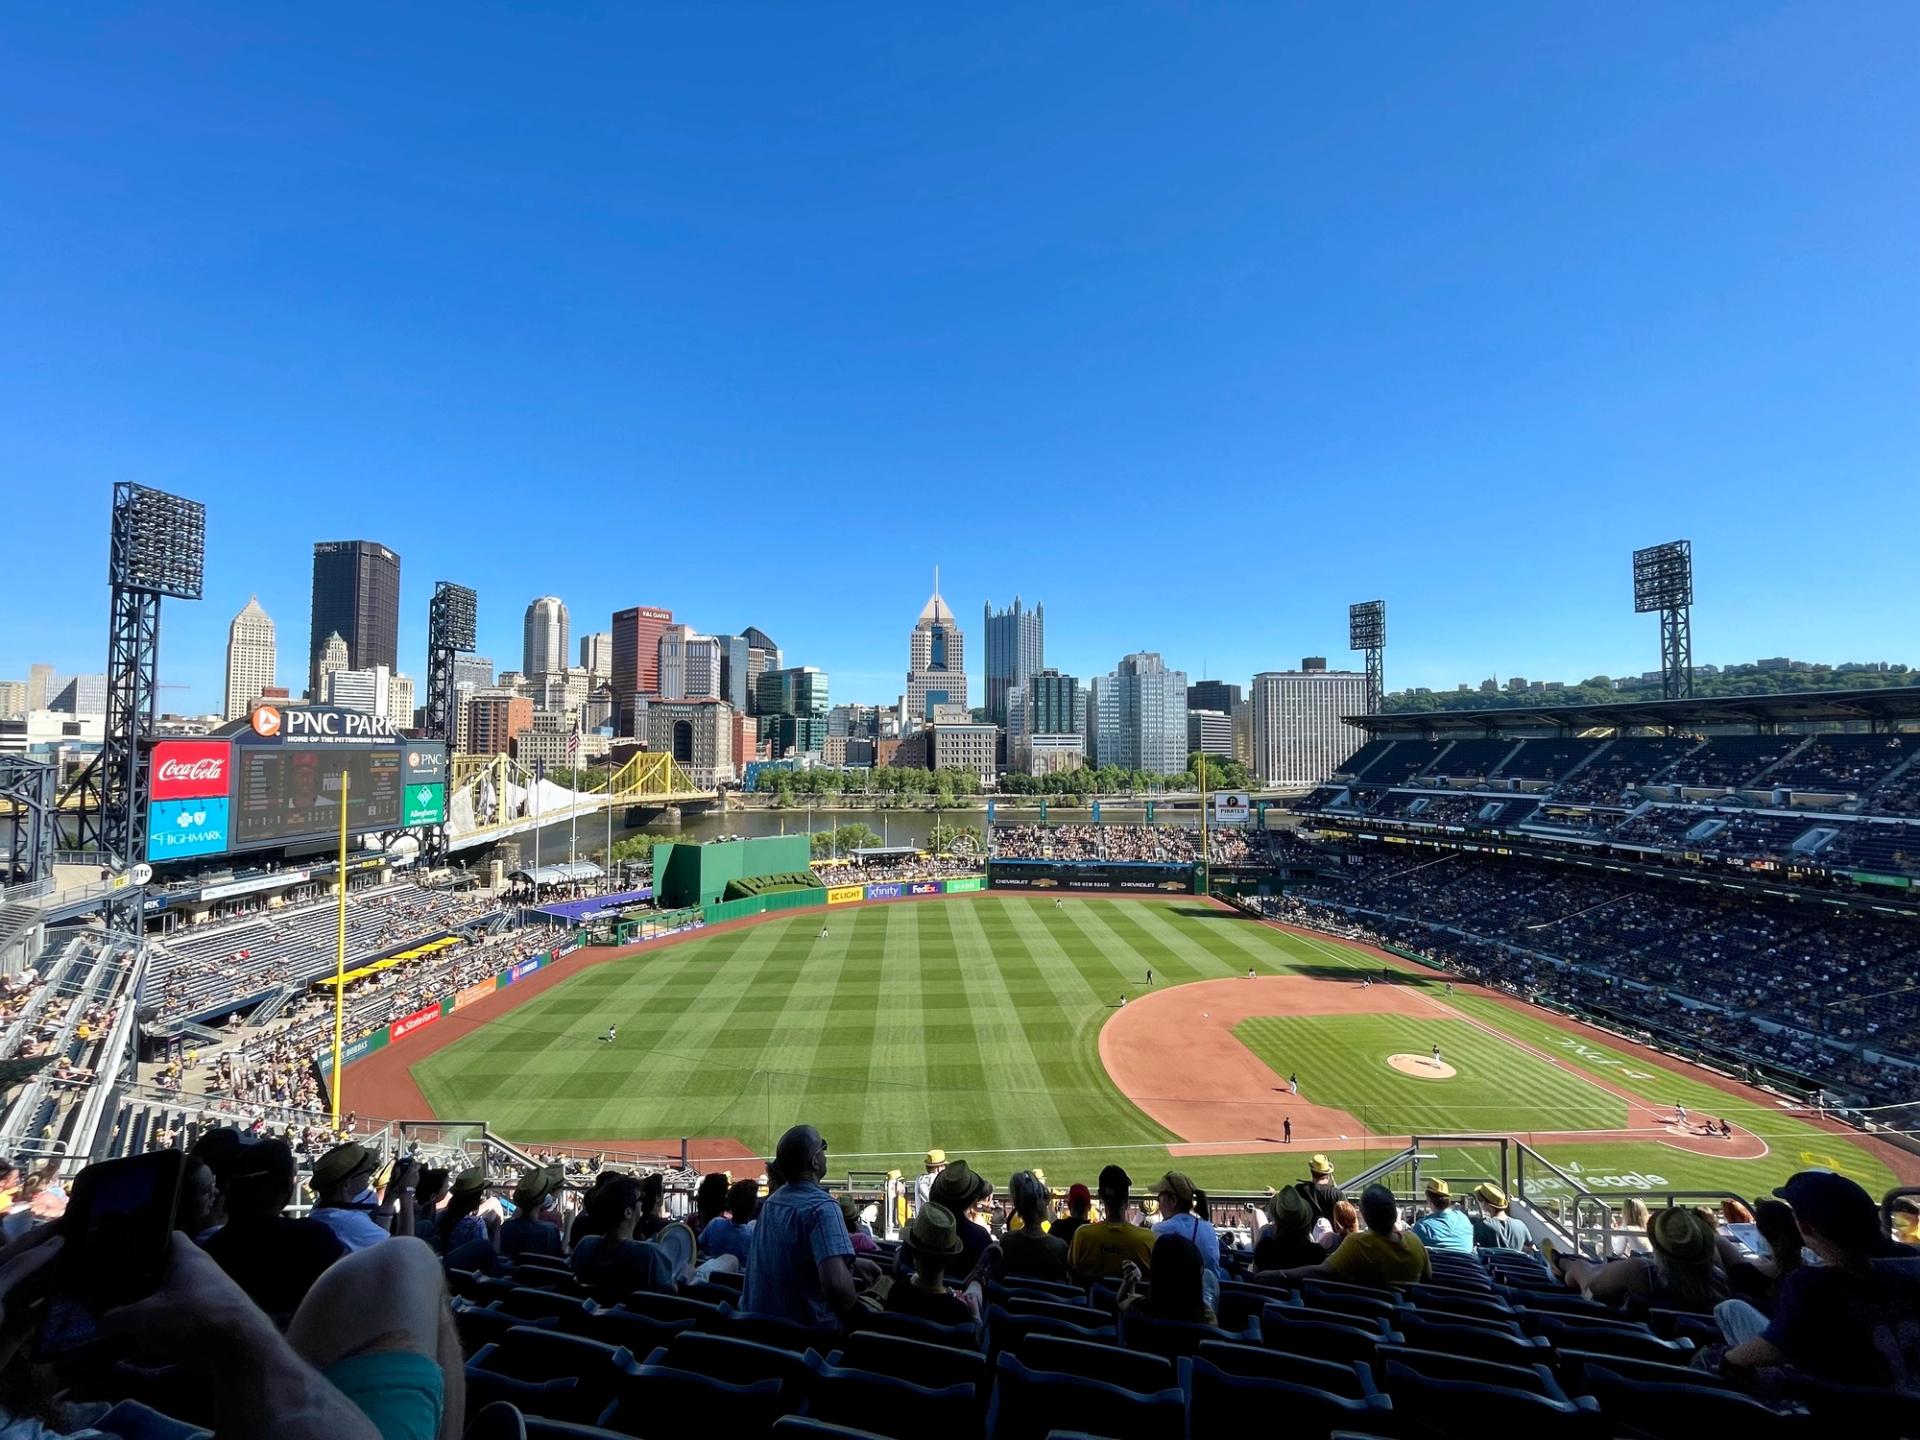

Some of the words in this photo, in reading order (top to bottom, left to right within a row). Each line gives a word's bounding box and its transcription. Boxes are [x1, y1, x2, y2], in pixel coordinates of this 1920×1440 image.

[285, 710, 338, 734] PNC
[343, 713, 397, 736] PARK
[421, 754, 443, 765] PNC
[158, 758, 225, 781] Coca-Cola
[151, 830, 224, 845] HIGHMARK
[840, 890, 860, 899] LIGHT
[870, 886, 899, 898] xfinity
[912, 884, 936, 893] FedEx
[1586, 1171, 1668, 1190] eagle
